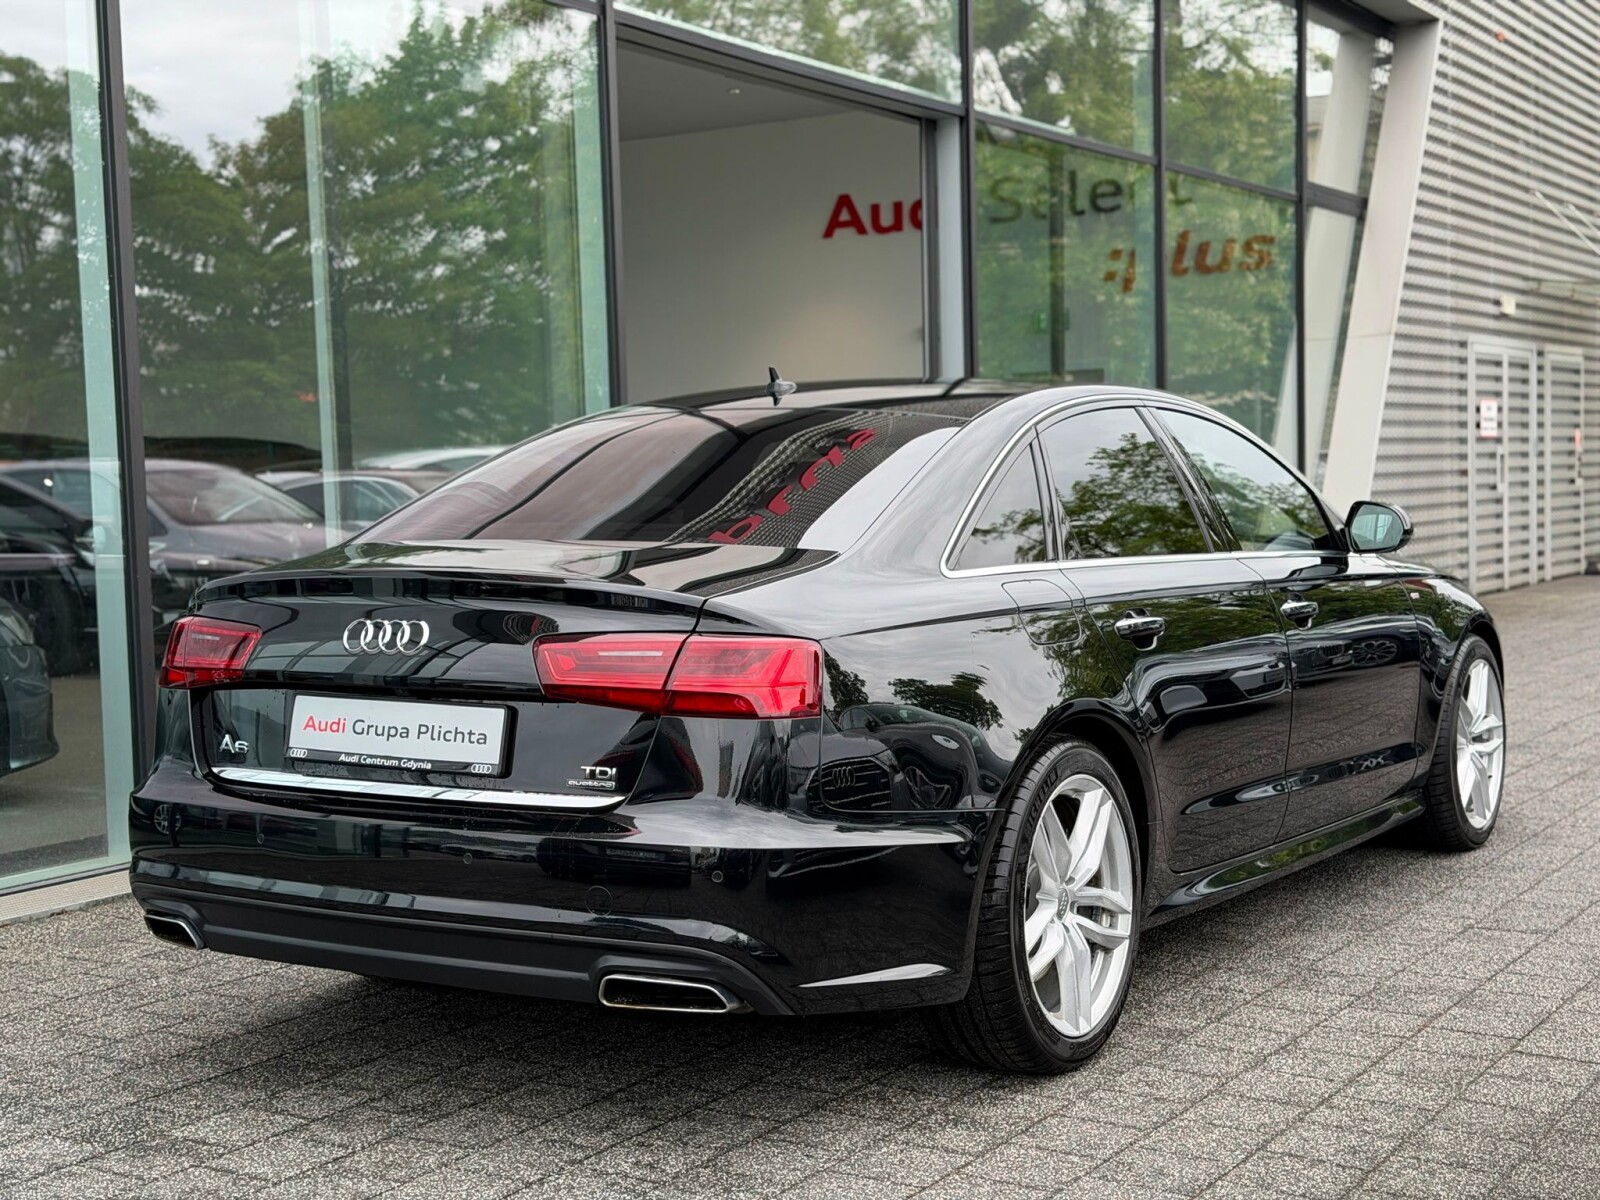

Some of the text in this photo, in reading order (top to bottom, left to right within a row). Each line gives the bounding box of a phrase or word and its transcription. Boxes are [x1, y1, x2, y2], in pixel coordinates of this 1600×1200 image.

[303, 715, 488, 745] Audi Grupa Plichta
[218, 734, 249, 754] A6
[338, 753, 432, 770] Audi Centrum Gdynia
[580, 765, 617, 780] TDI
[567, 779, 614, 789] quattro
